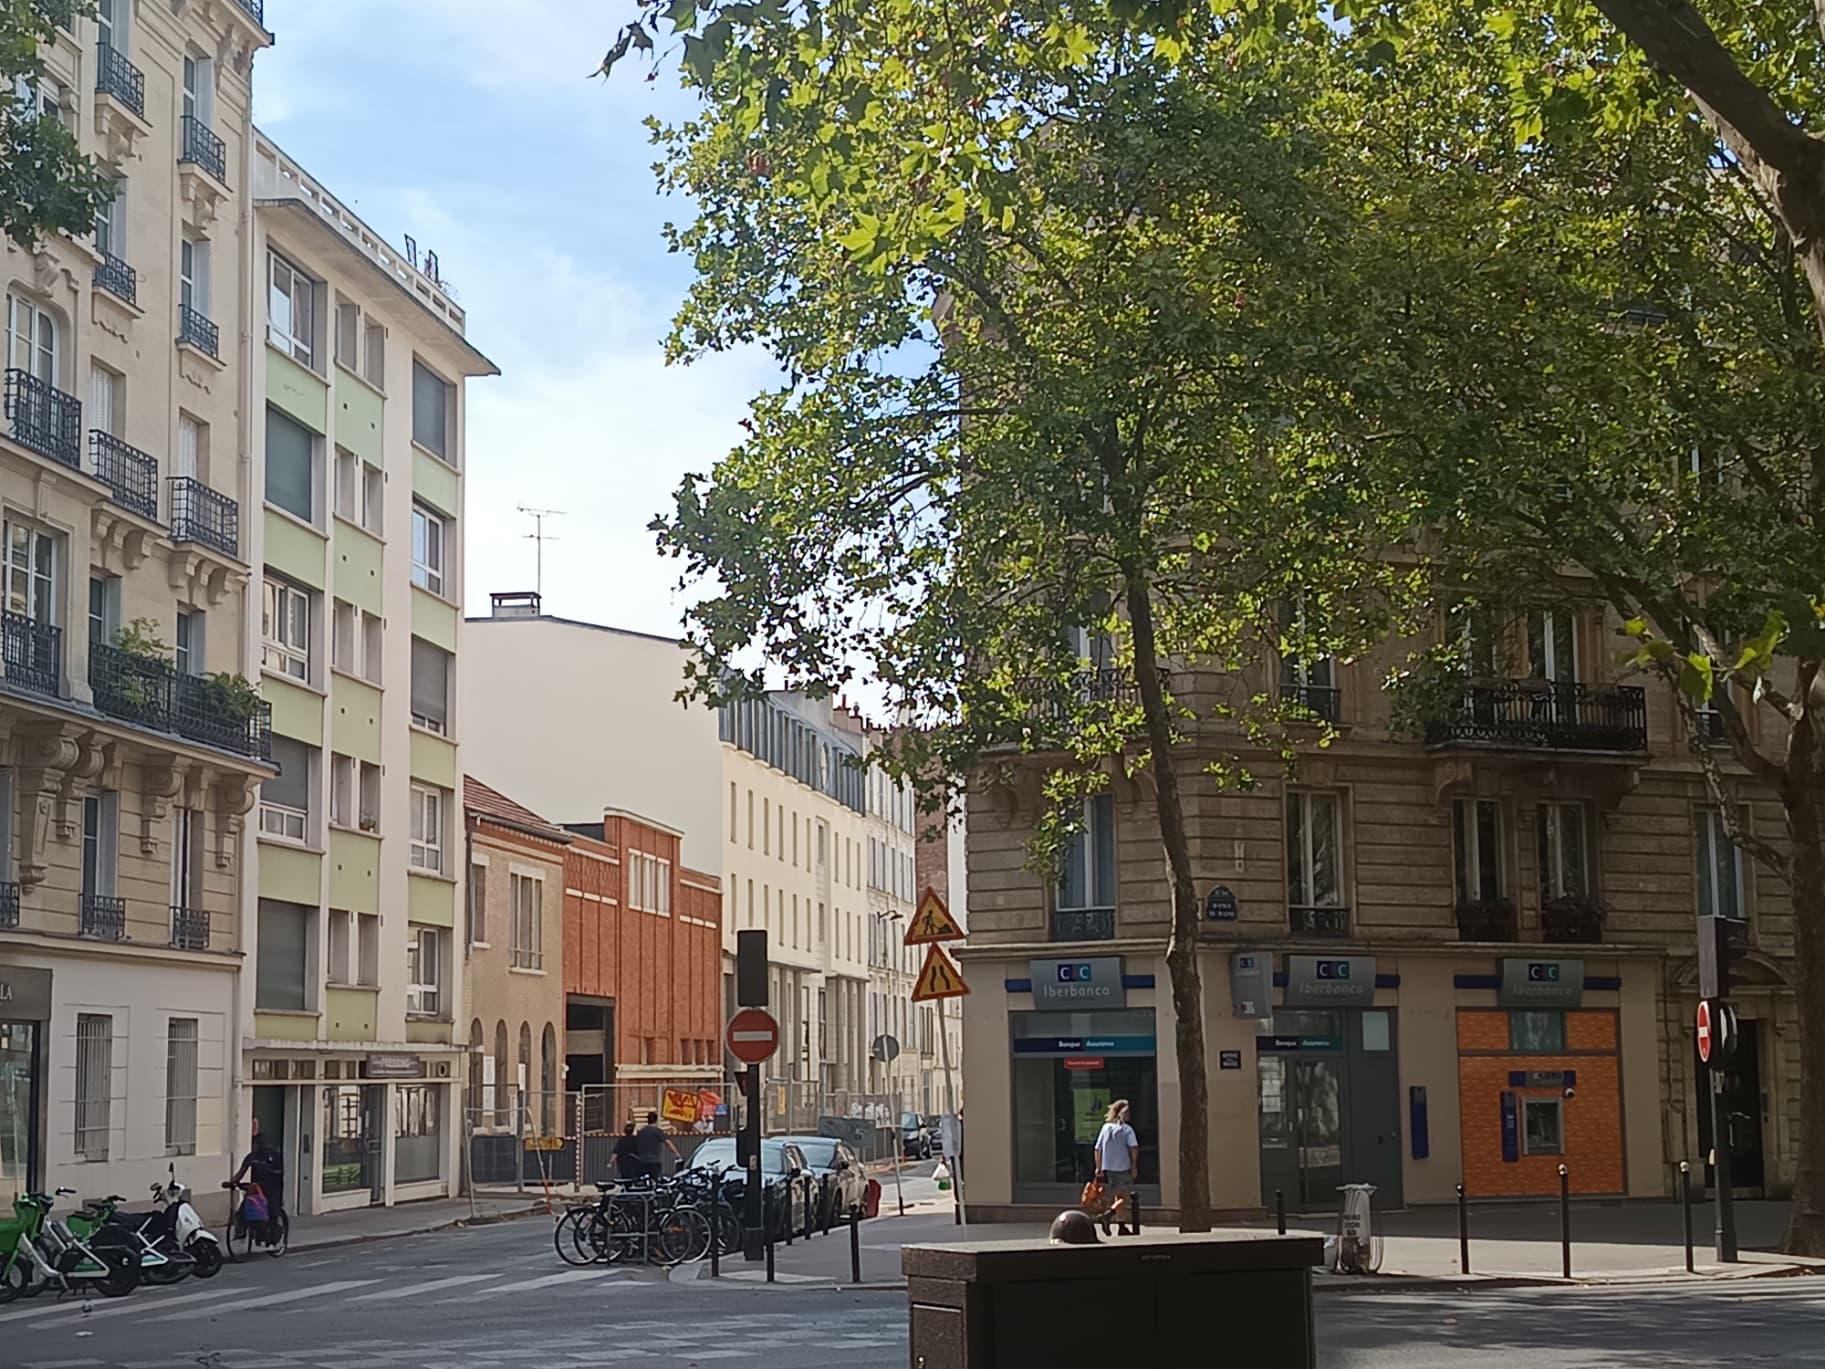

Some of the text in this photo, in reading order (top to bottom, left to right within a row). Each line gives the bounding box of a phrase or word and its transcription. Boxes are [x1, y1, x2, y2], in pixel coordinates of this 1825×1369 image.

[1059, 966, 1090, 980] CIC
[1318, 963, 1348, 977] CIC
[1530, 966, 1558, 979] CIC
[1043, 985, 1110, 998] Iberbanco
[1299, 981, 1364, 994] Iberbanco
[1512, 983, 1573, 996] Iberbanco
